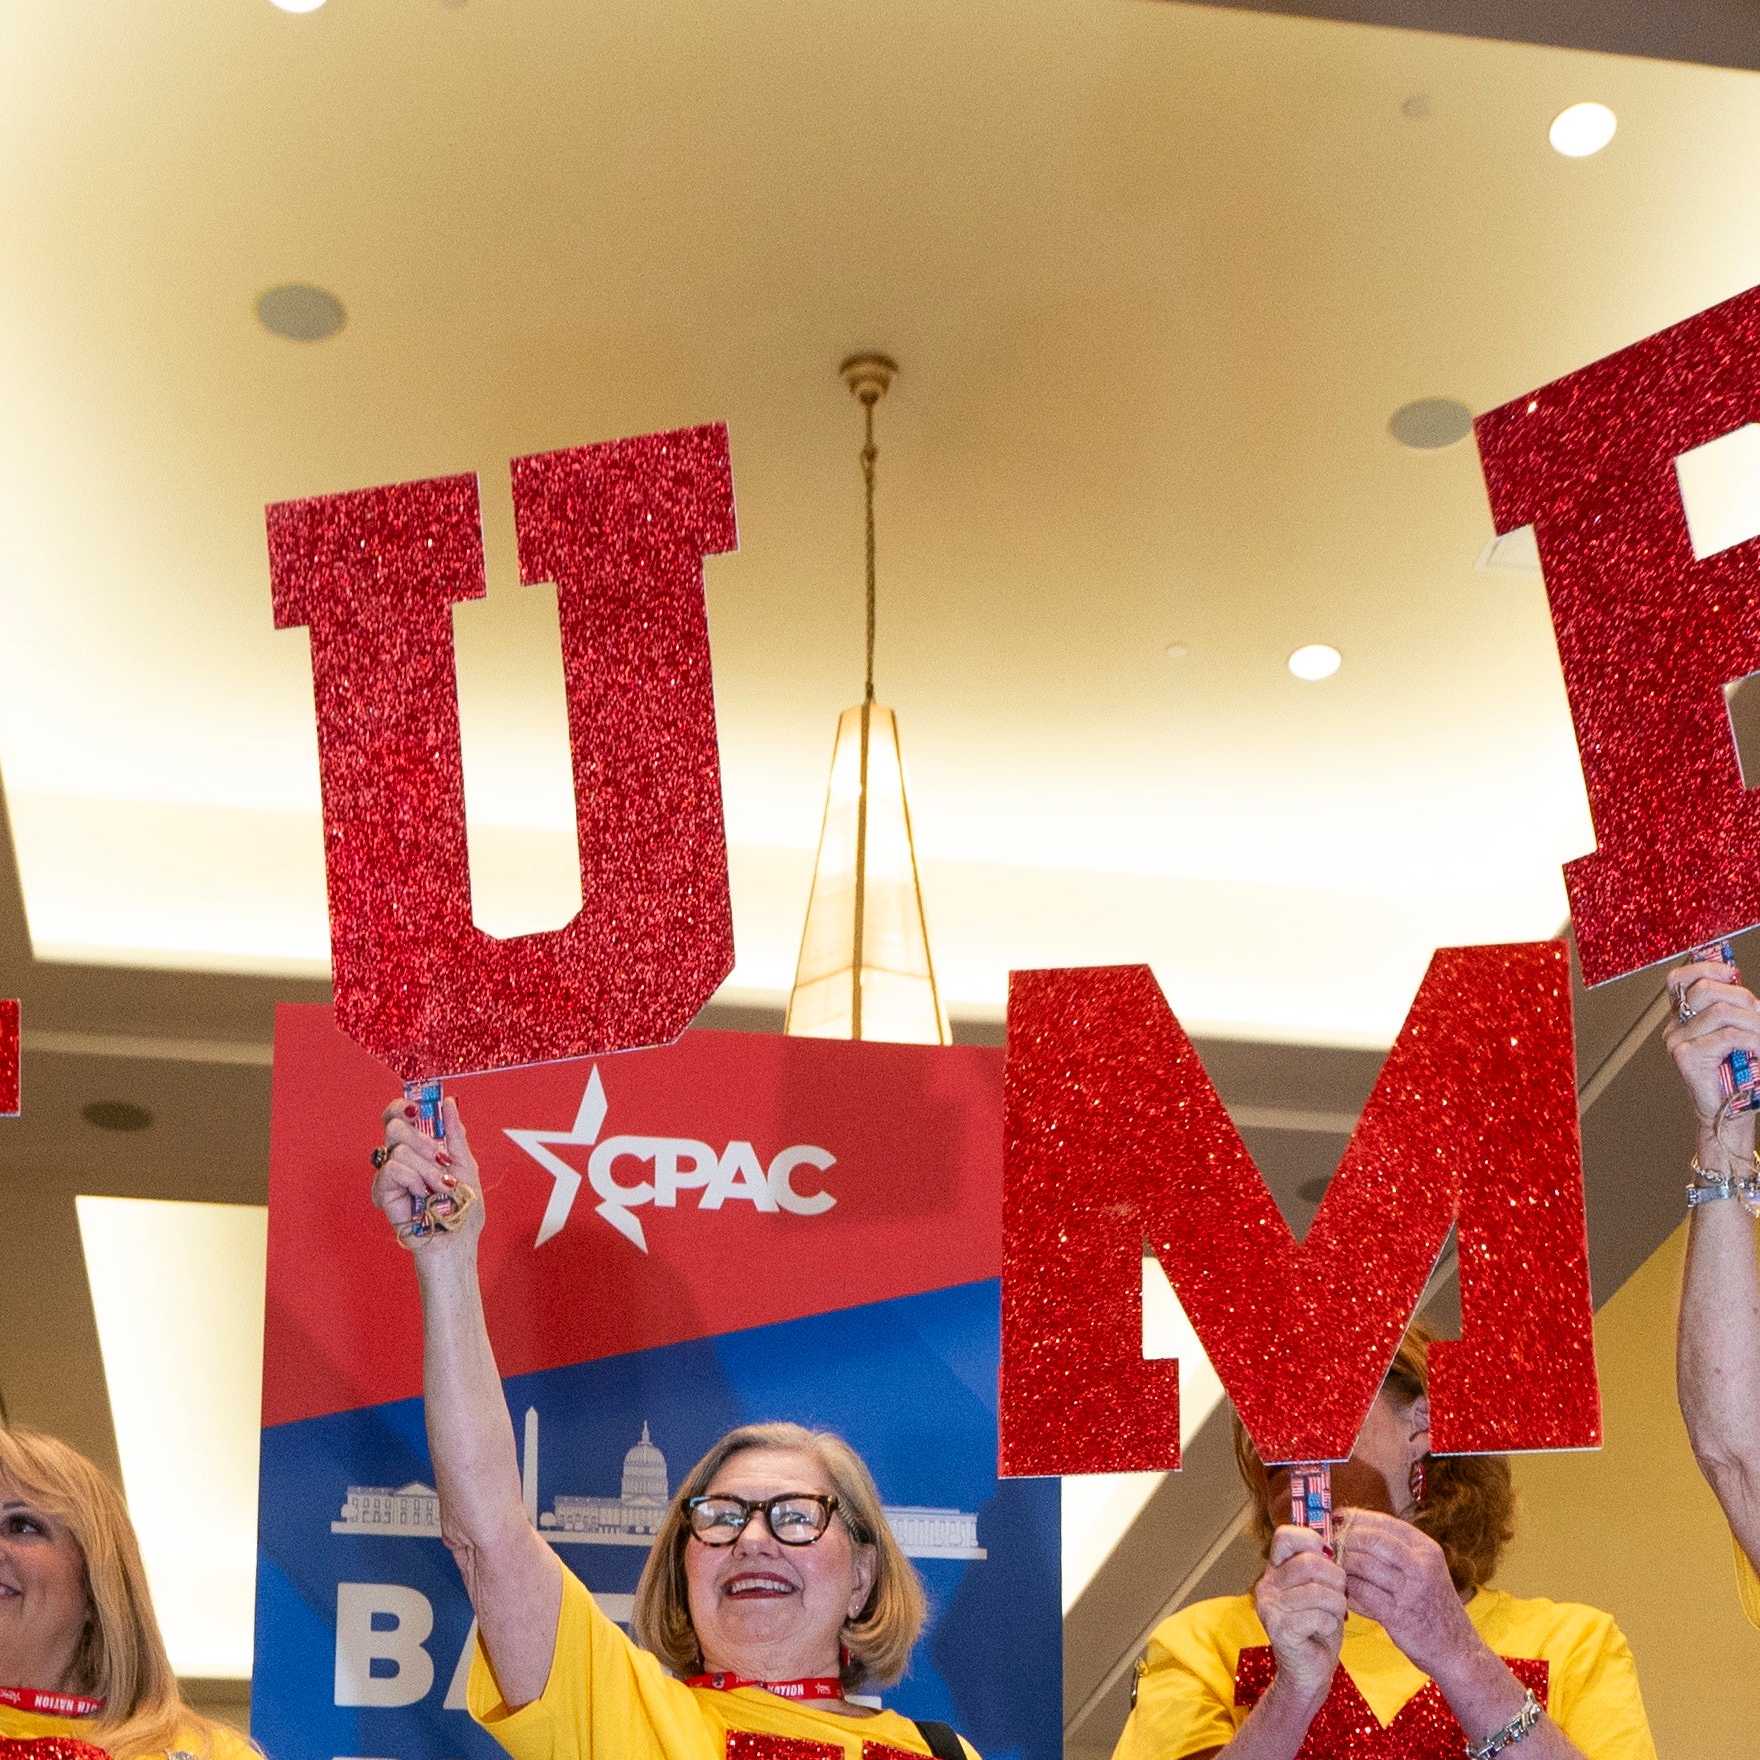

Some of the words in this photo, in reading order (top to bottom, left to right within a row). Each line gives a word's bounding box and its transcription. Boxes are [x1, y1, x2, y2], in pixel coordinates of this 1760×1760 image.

[265, 421, 740, 1082] U
[588, 1135, 837, 1216] CPAC
[998, 938, 1602, 1478] M
[34, 1694, 73, 1713] NATION
